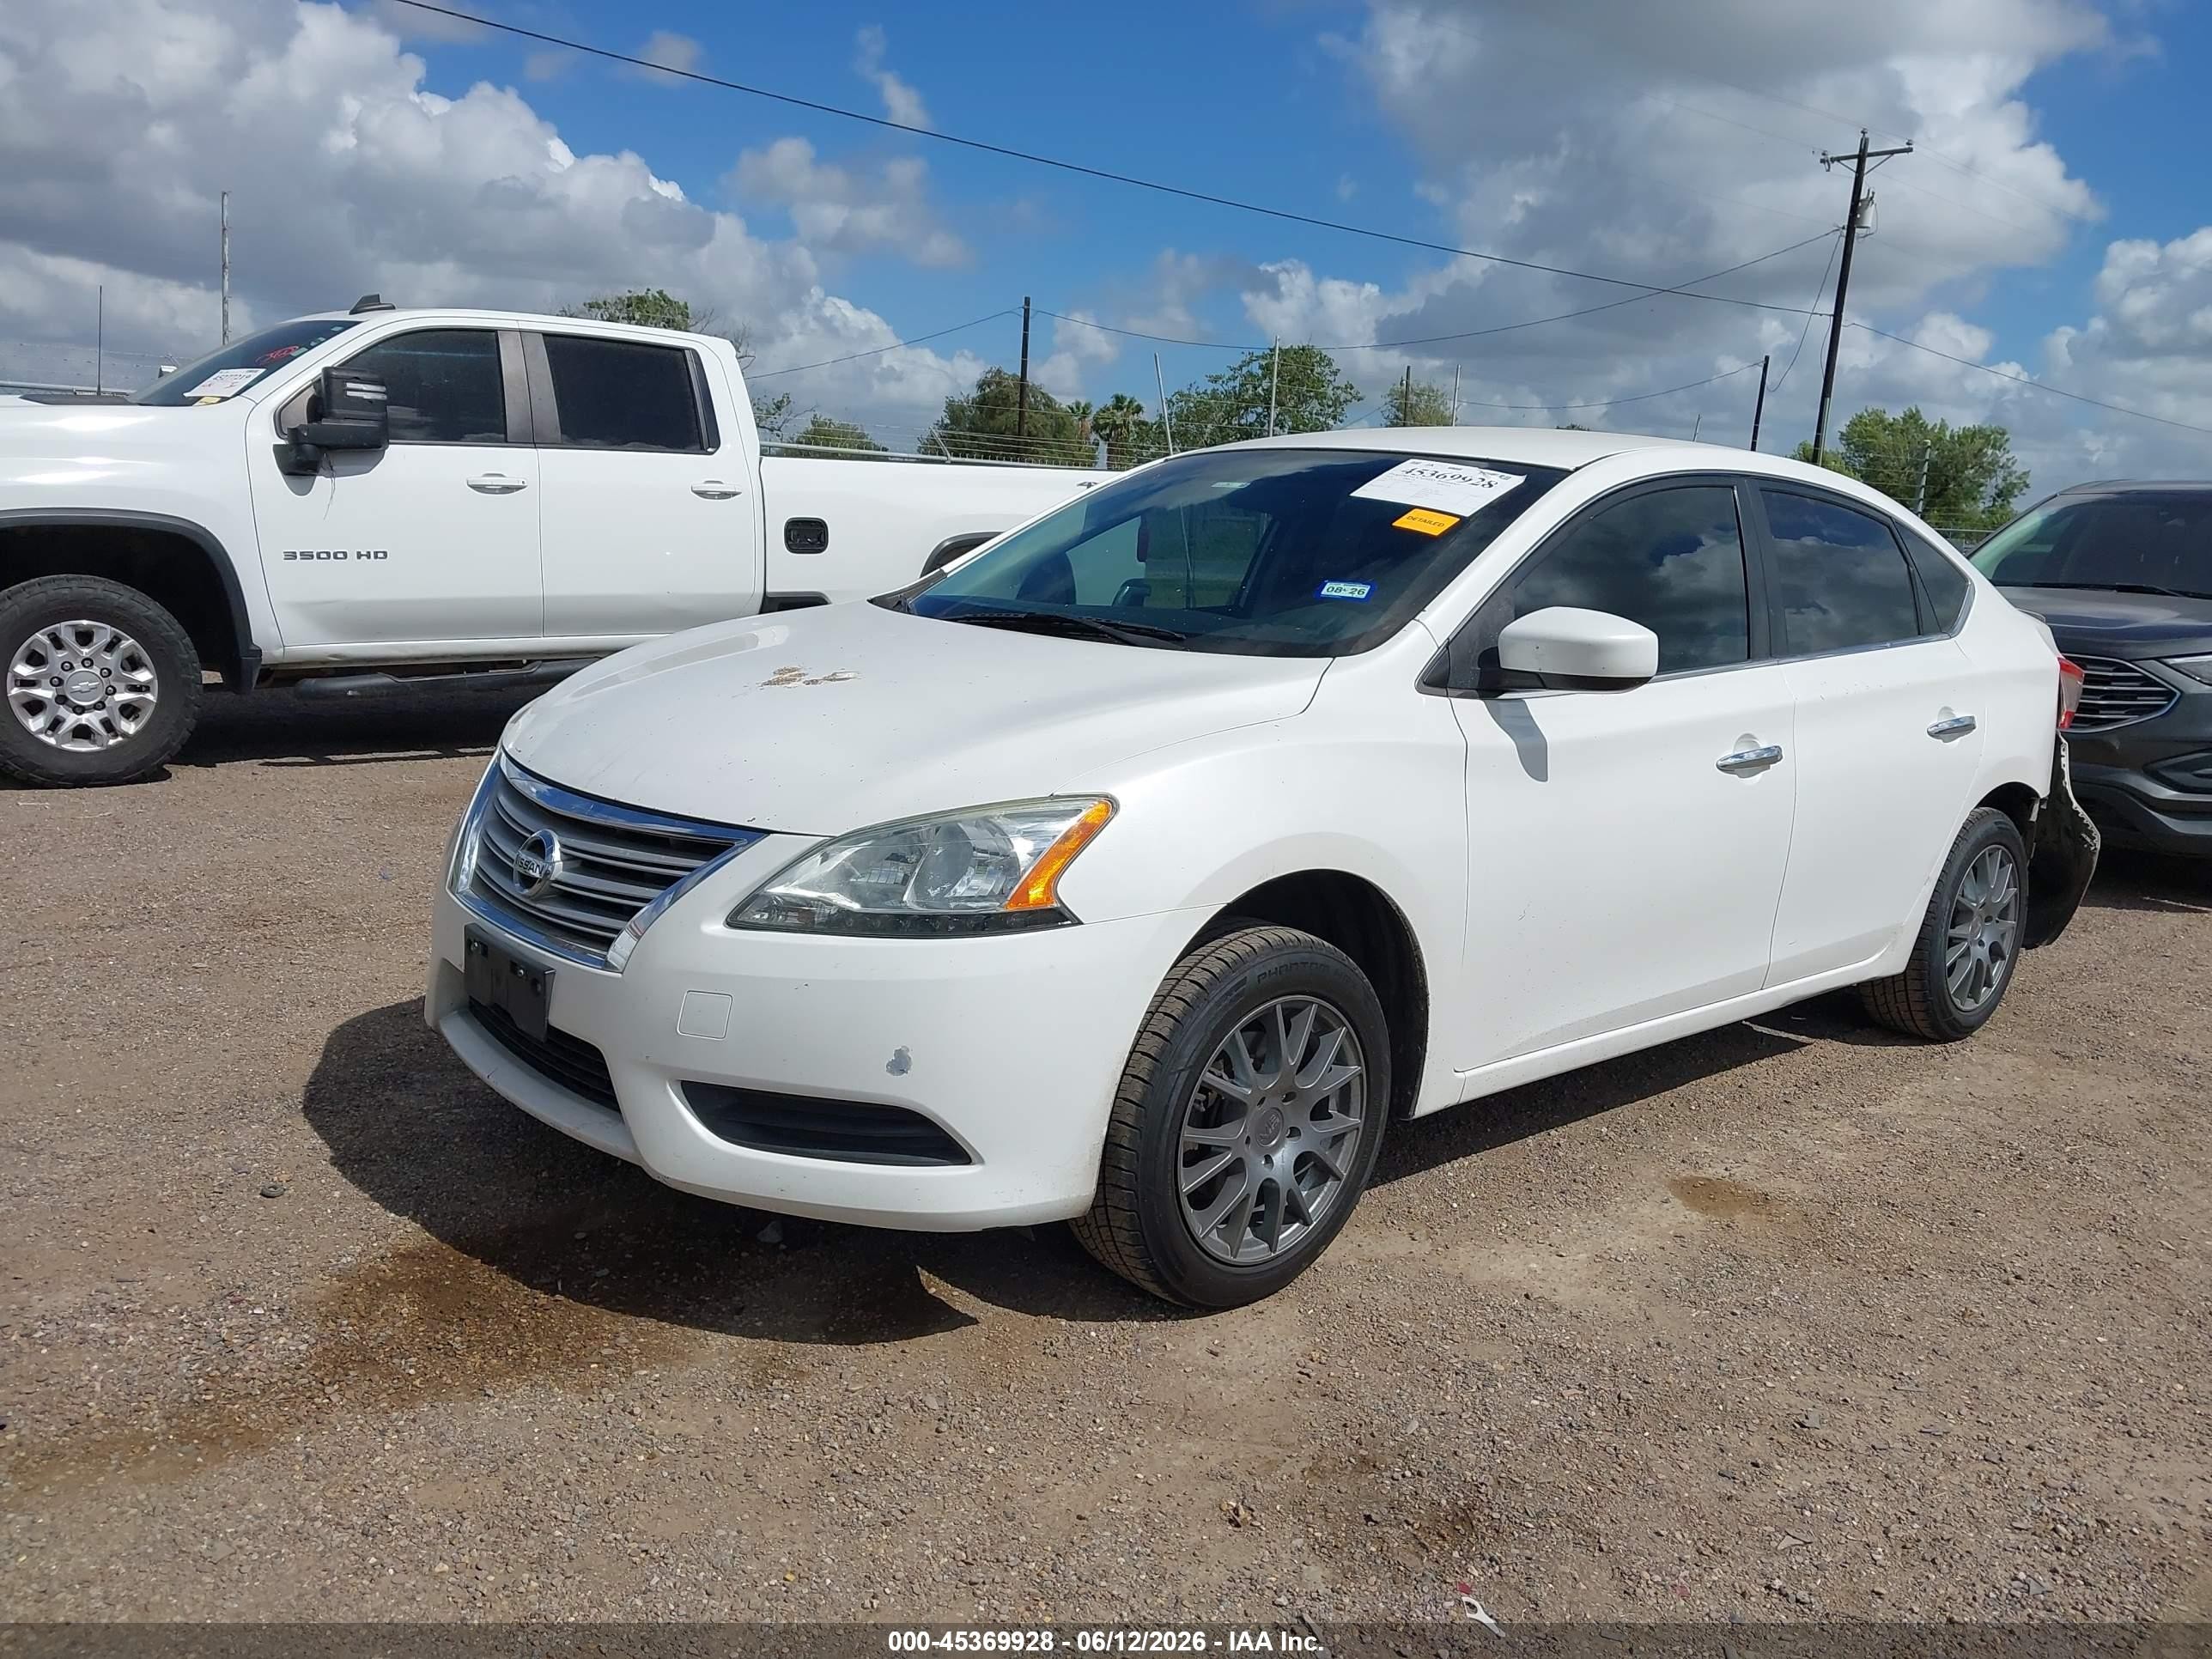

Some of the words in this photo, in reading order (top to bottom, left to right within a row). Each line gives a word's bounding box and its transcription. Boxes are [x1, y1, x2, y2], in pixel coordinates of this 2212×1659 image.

[1401, 467, 1498, 489] 45369928
[1407, 515, 1445, 527] DETAILED
[283, 550, 348, 560] 3500
[356, 550, 388, 560] HD
